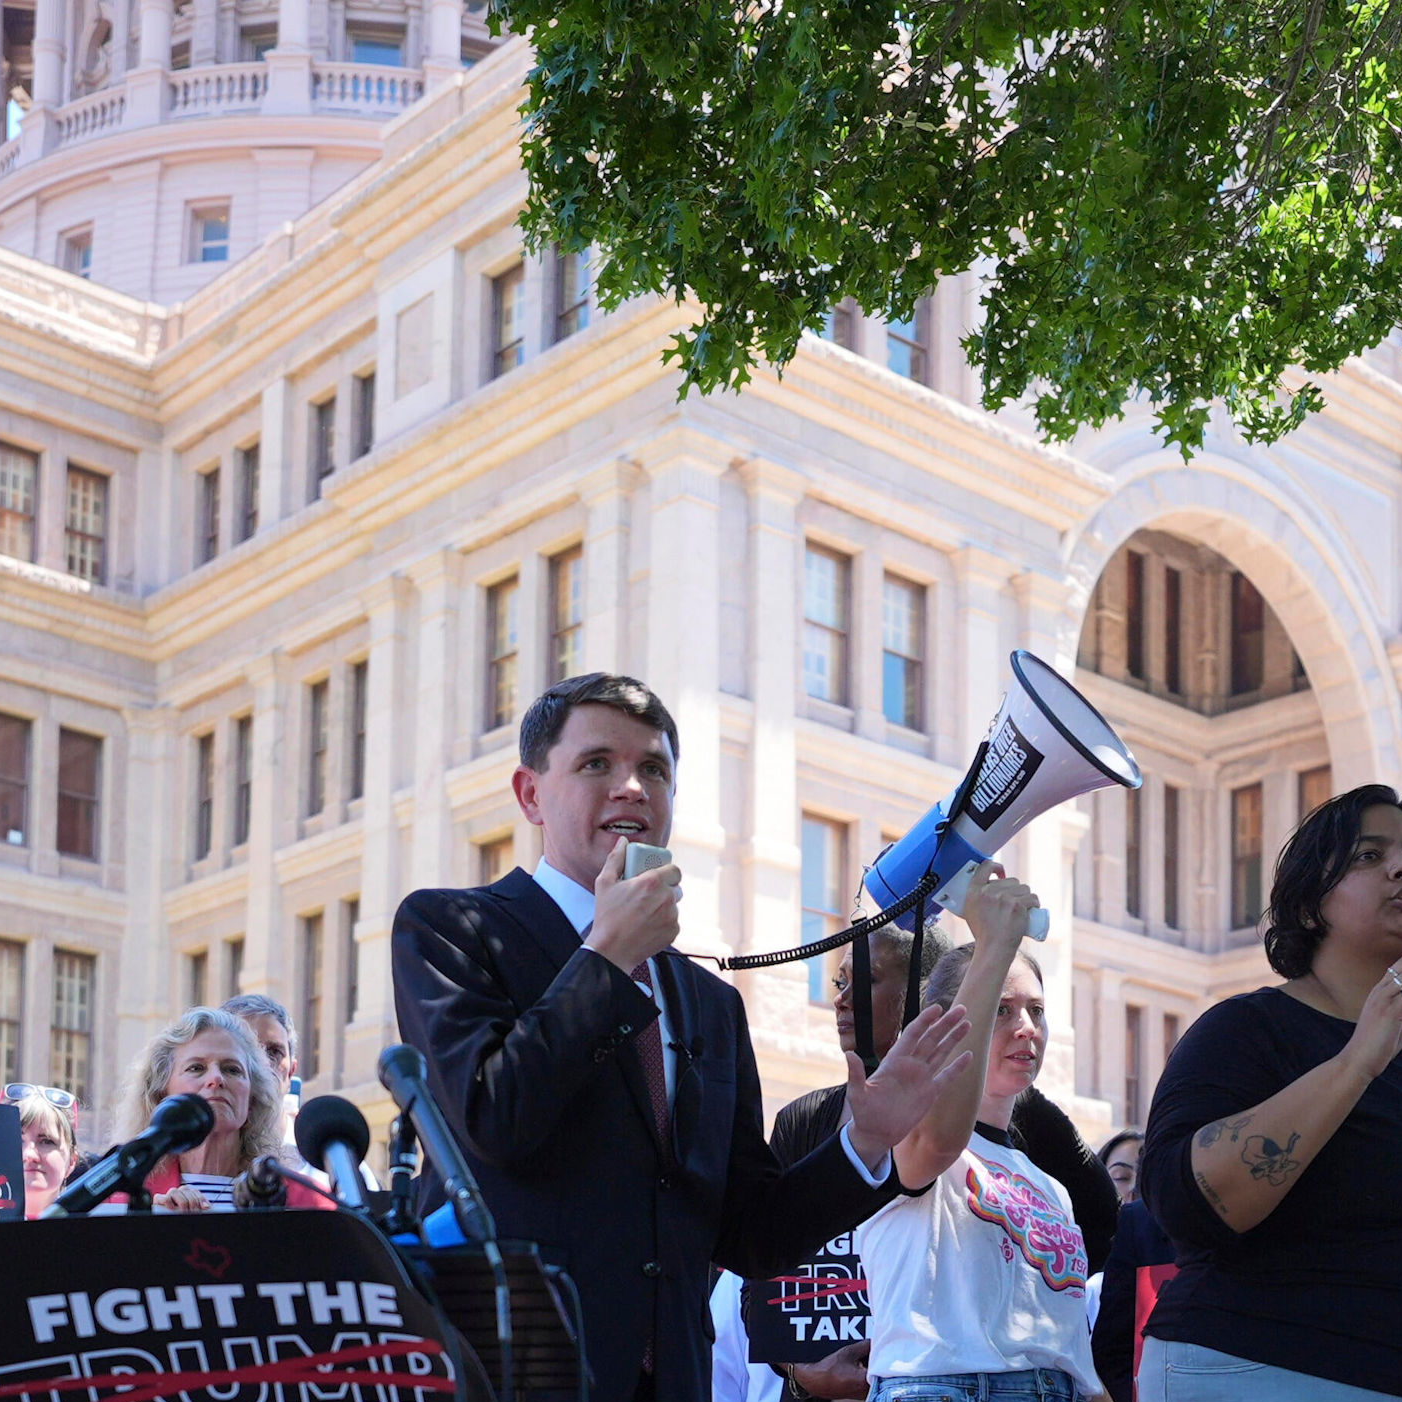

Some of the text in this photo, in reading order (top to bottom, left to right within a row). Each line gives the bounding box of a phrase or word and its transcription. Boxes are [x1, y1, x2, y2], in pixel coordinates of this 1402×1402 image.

[998, 721, 1016, 757] OVER
[969, 741, 1028, 813] BILLIONAIRES
[27, 1281, 404, 1344] FIGHT THE
